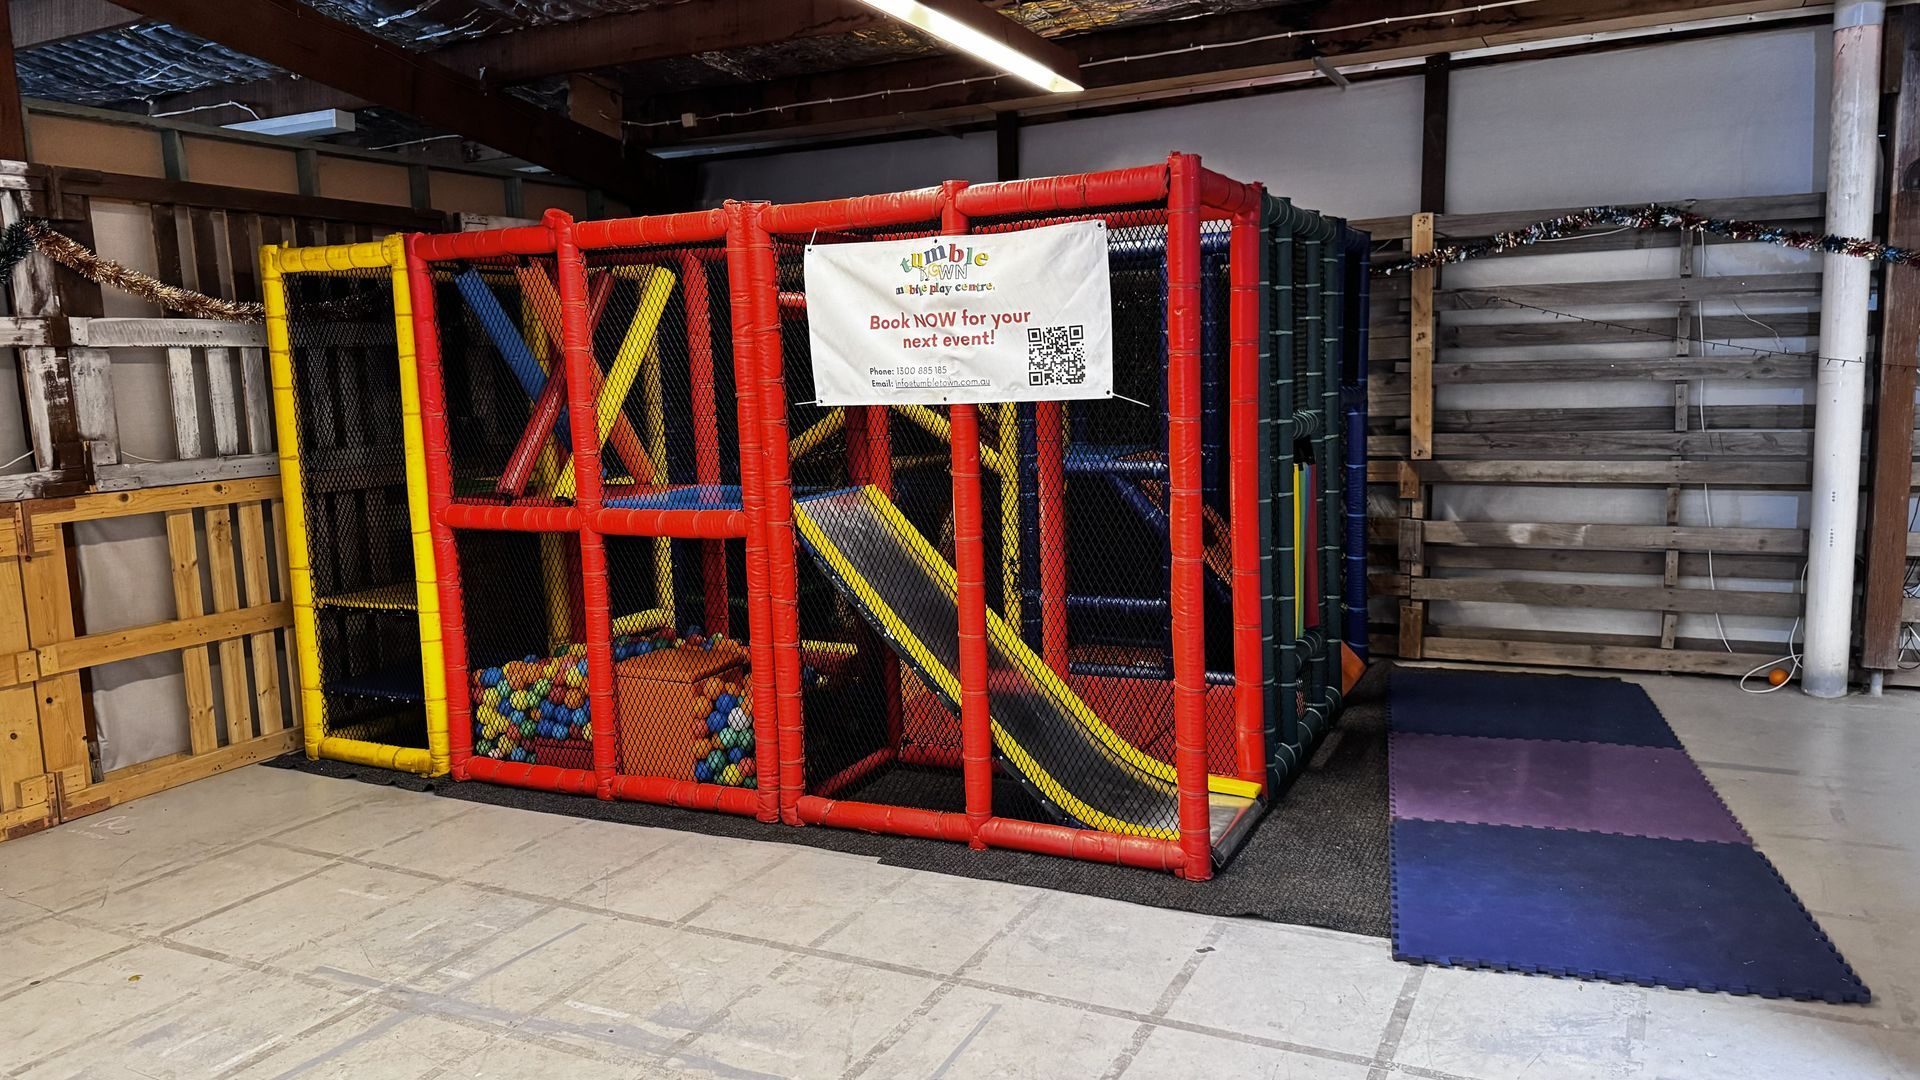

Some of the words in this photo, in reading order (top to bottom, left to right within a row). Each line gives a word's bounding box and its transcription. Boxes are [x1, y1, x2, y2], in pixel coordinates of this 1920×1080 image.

[900, 243, 989, 273] tumble
[896, 284, 927, 296] mbile
[929, 282, 952, 296] play
[870, 312, 910, 330] Book
[913, 311, 956, 328] NOW
[962, 309, 986, 326] for
[991, 311, 1031, 330] your
[903, 333, 938, 349] next
[943, 329, 995, 347] event!
[870, 366, 895, 376] Phone:
[896, 366, 916, 376] 1300
[935, 365, 948, 375] 185
[872, 379, 894, 388] Email:
